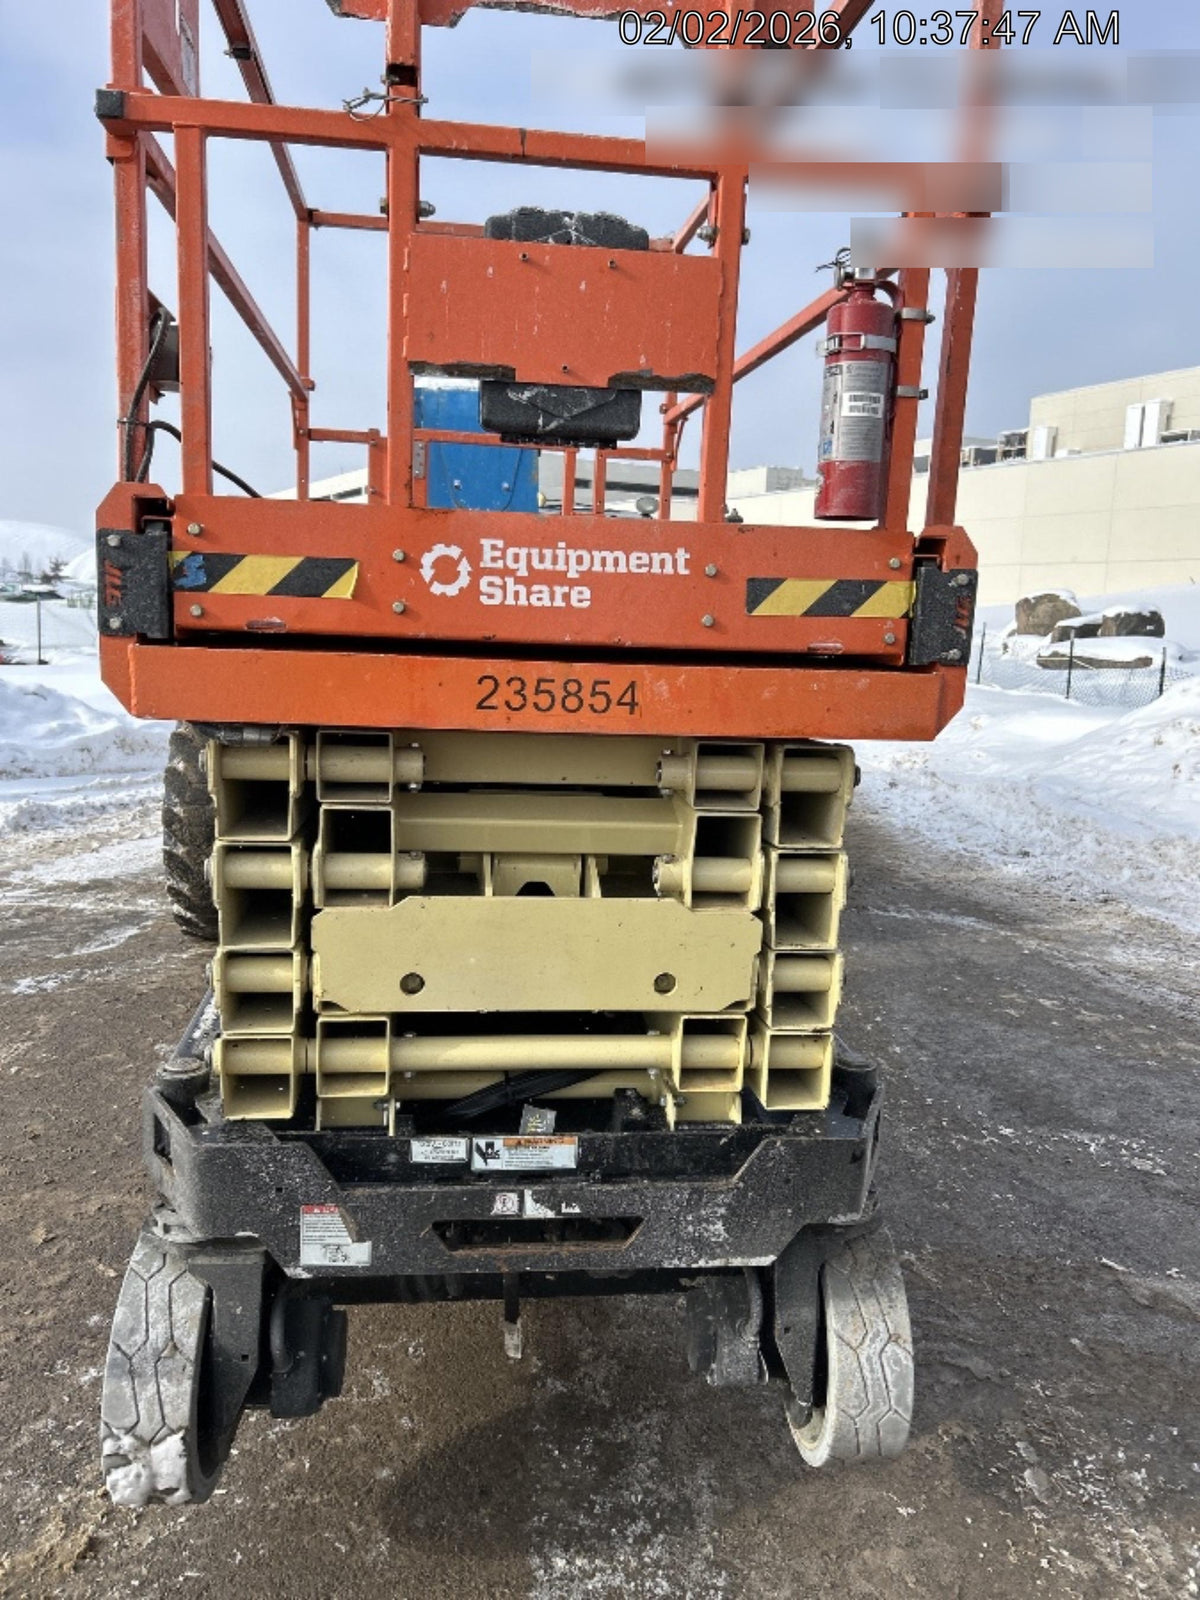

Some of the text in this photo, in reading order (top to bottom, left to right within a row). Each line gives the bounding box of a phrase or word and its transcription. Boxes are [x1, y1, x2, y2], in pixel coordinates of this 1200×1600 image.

[480, 538, 691, 578] Equipment
[479, 575, 592, 608] Share
[476, 675, 639, 715] 235854
